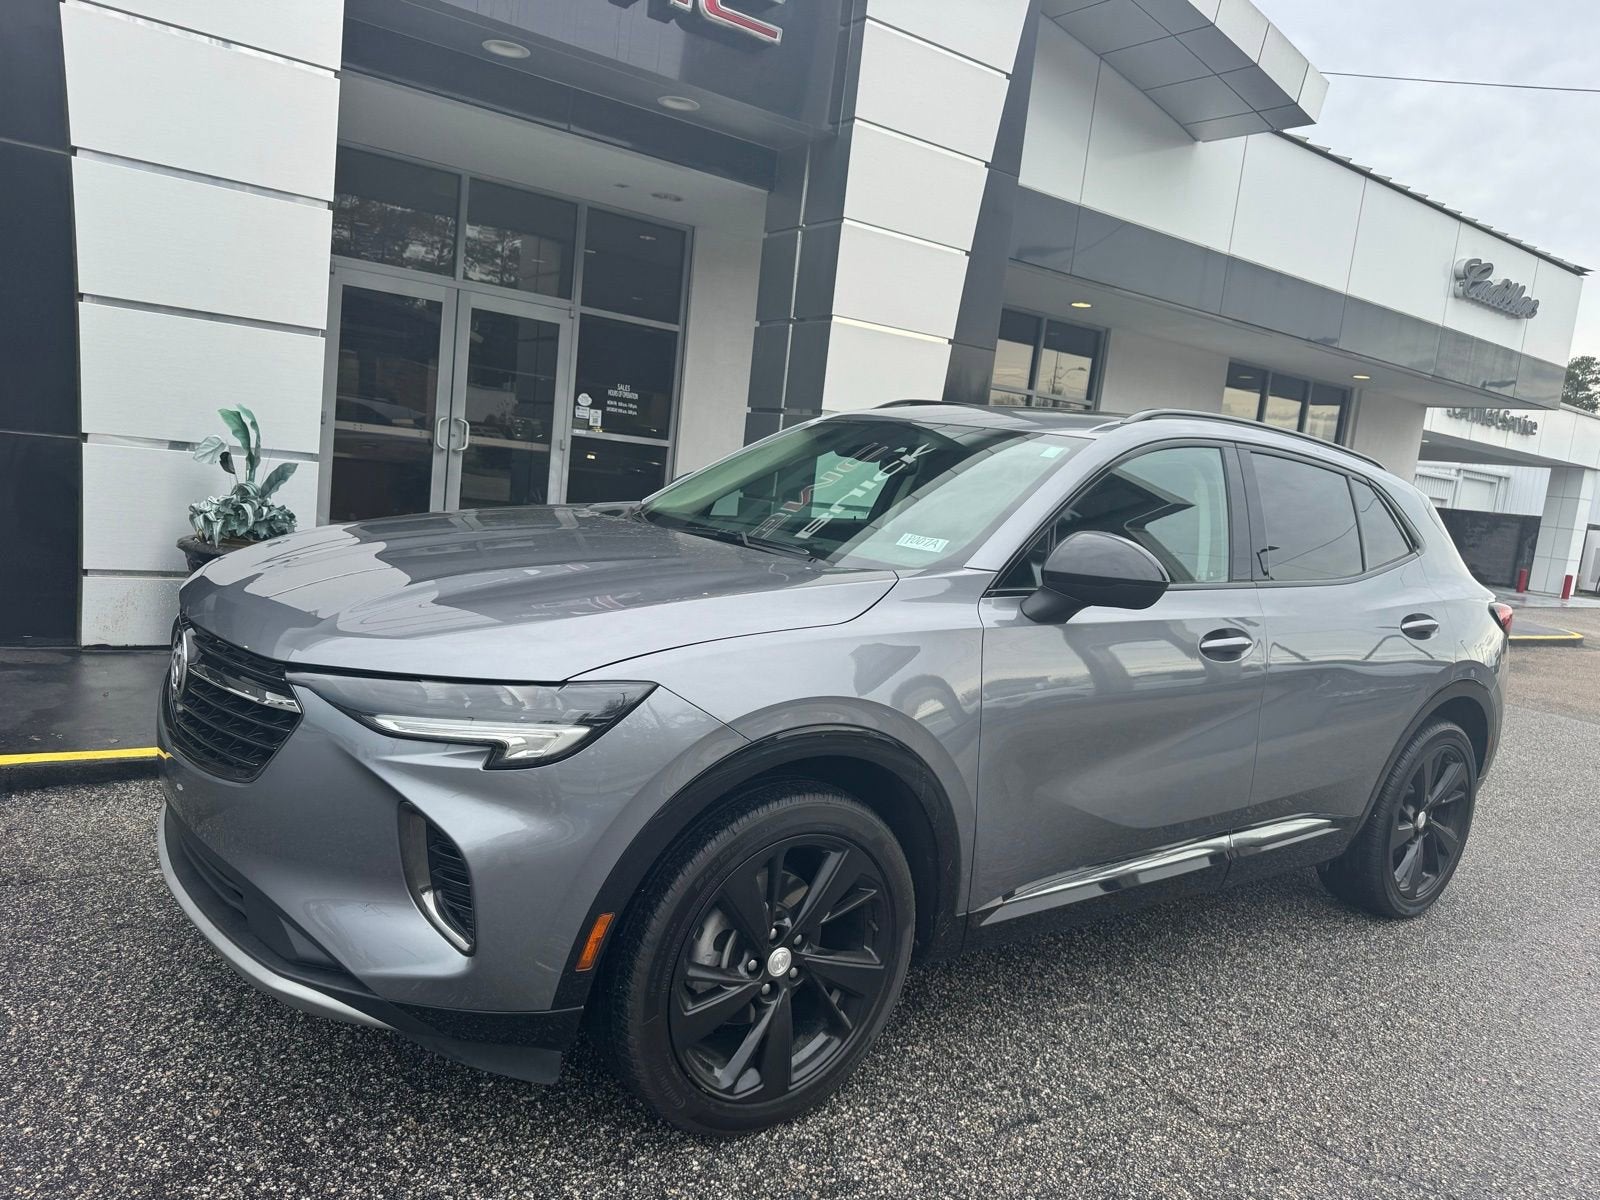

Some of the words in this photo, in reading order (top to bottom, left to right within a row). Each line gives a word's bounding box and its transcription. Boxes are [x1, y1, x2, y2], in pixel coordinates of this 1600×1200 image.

[1456, 258, 1540, 320] Cadillac
[617, 384, 631, 392] SALES
[1502, 410, 1538, 436] Service
